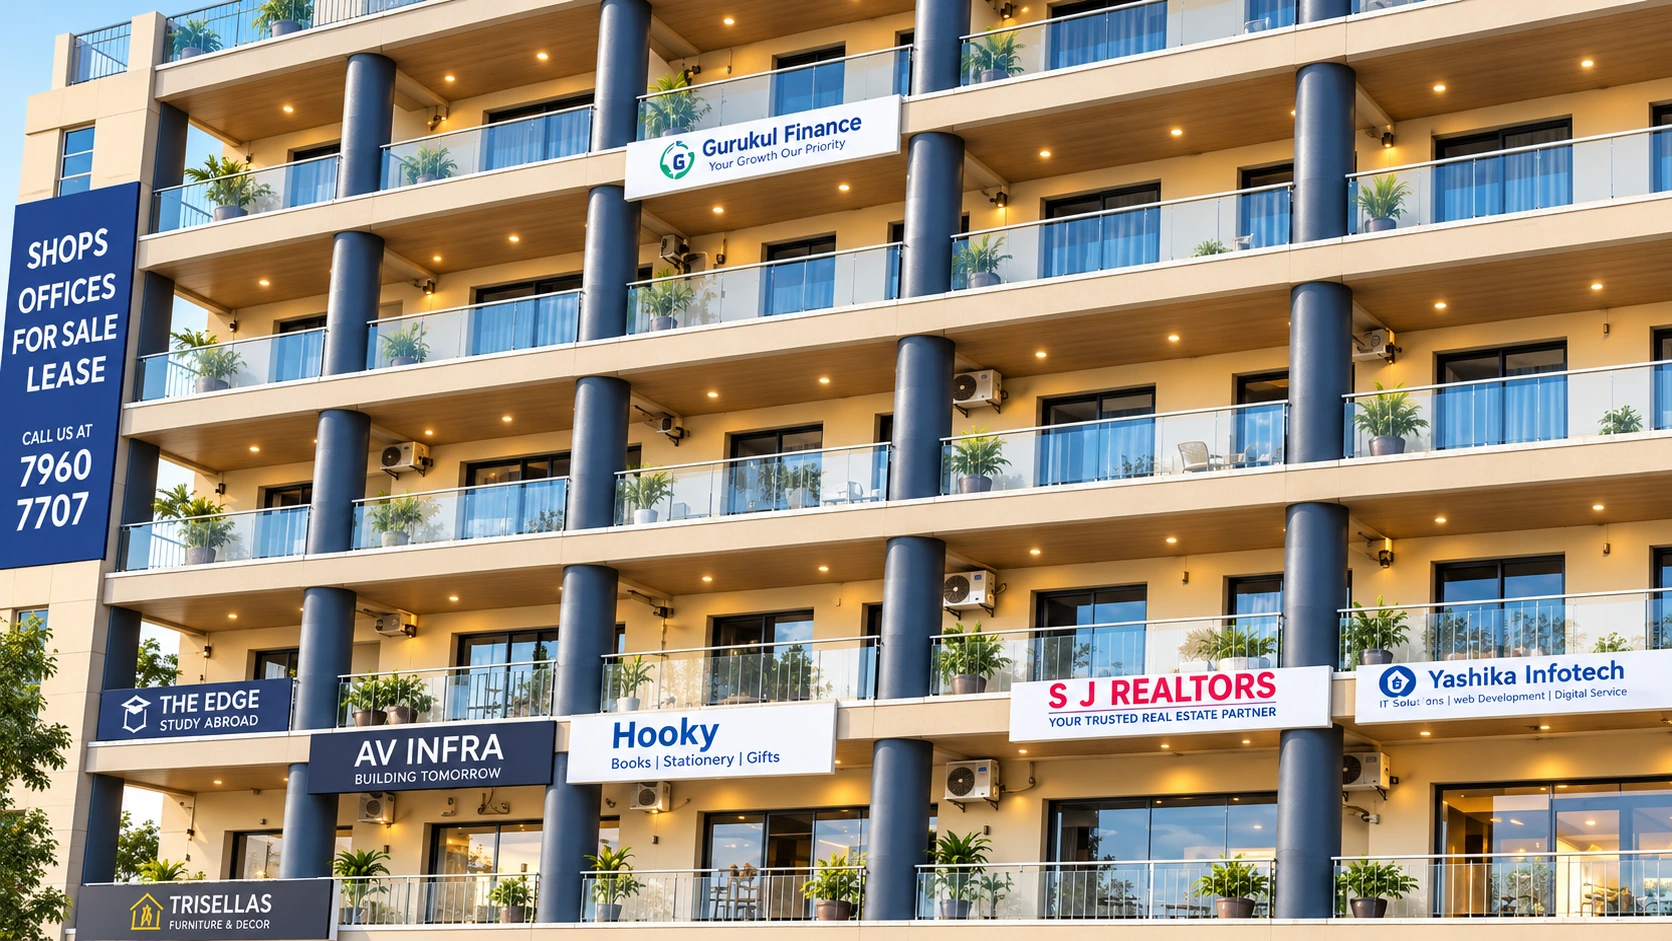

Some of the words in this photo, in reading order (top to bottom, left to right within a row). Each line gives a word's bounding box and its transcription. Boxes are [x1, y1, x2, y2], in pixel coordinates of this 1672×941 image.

[702, 127, 777, 157] Gurukul
[785, 117, 861, 143] Finance
[709, 161, 734, 171] Your
[737, 151, 777, 166] Growth
[781, 148, 802, 158] Our
[806, 140, 845, 154] Priority
[27, 228, 108, 269] SHOPS
[19, 273, 116, 313] OFFICES
[12, 324, 57, 354] FOR
[62, 314, 118, 346] SALE
[27, 356, 106, 392] LEASE
[22, 429, 53, 445] CALL
[57, 426, 73, 441] US
[76, 424, 93, 438] AT
[20, 449, 91, 487] 7960
[17, 492, 89, 531] 7707
[1428, 666, 1516, 688] Yashika
[1526, 660, 1624, 684] Infotech
[160, 694, 199, 714] THE
[205, 689, 260, 711] EDGE
[1049, 683, 1067, 709] S
[1080, 681, 1095, 707] J
[1111, 671, 1276, 705] REALTORS
[1380, 700, 1389, 708] IT
[1454, 695, 1474, 704] web
[1479, 692, 1545, 703] Development
[1555, 689, 1587, 701] Digital
[1591, 687, 1627, 697] Service
[160, 718, 200, 731] STUDY
[204, 715, 258, 728] ABROAD
[1049, 717, 1081, 727] YOUR
[1085, 714, 1138, 725] TRUSTED
[1142, 712, 1172, 722] REAL
[1176, 710, 1217, 721] ESTATE
[1222, 707, 1276, 718] PARTNER
[613, 717, 719, 752] Hooky
[354, 739, 397, 767] AV
[407, 734, 504, 764] INFRA
[612, 756, 651, 769] Books
[664, 754, 734, 767] Stationery
[747, 751, 780, 763] Gifts
[355, 771, 416, 784] BUILDING
[421, 768, 501, 781] TOMORROW
[170, 894, 271, 914] TRISELLAS
[169, 920, 222, 929] FURNITURE
[226, 920, 232, 929] &
[236, 919, 270, 929] DECOR
